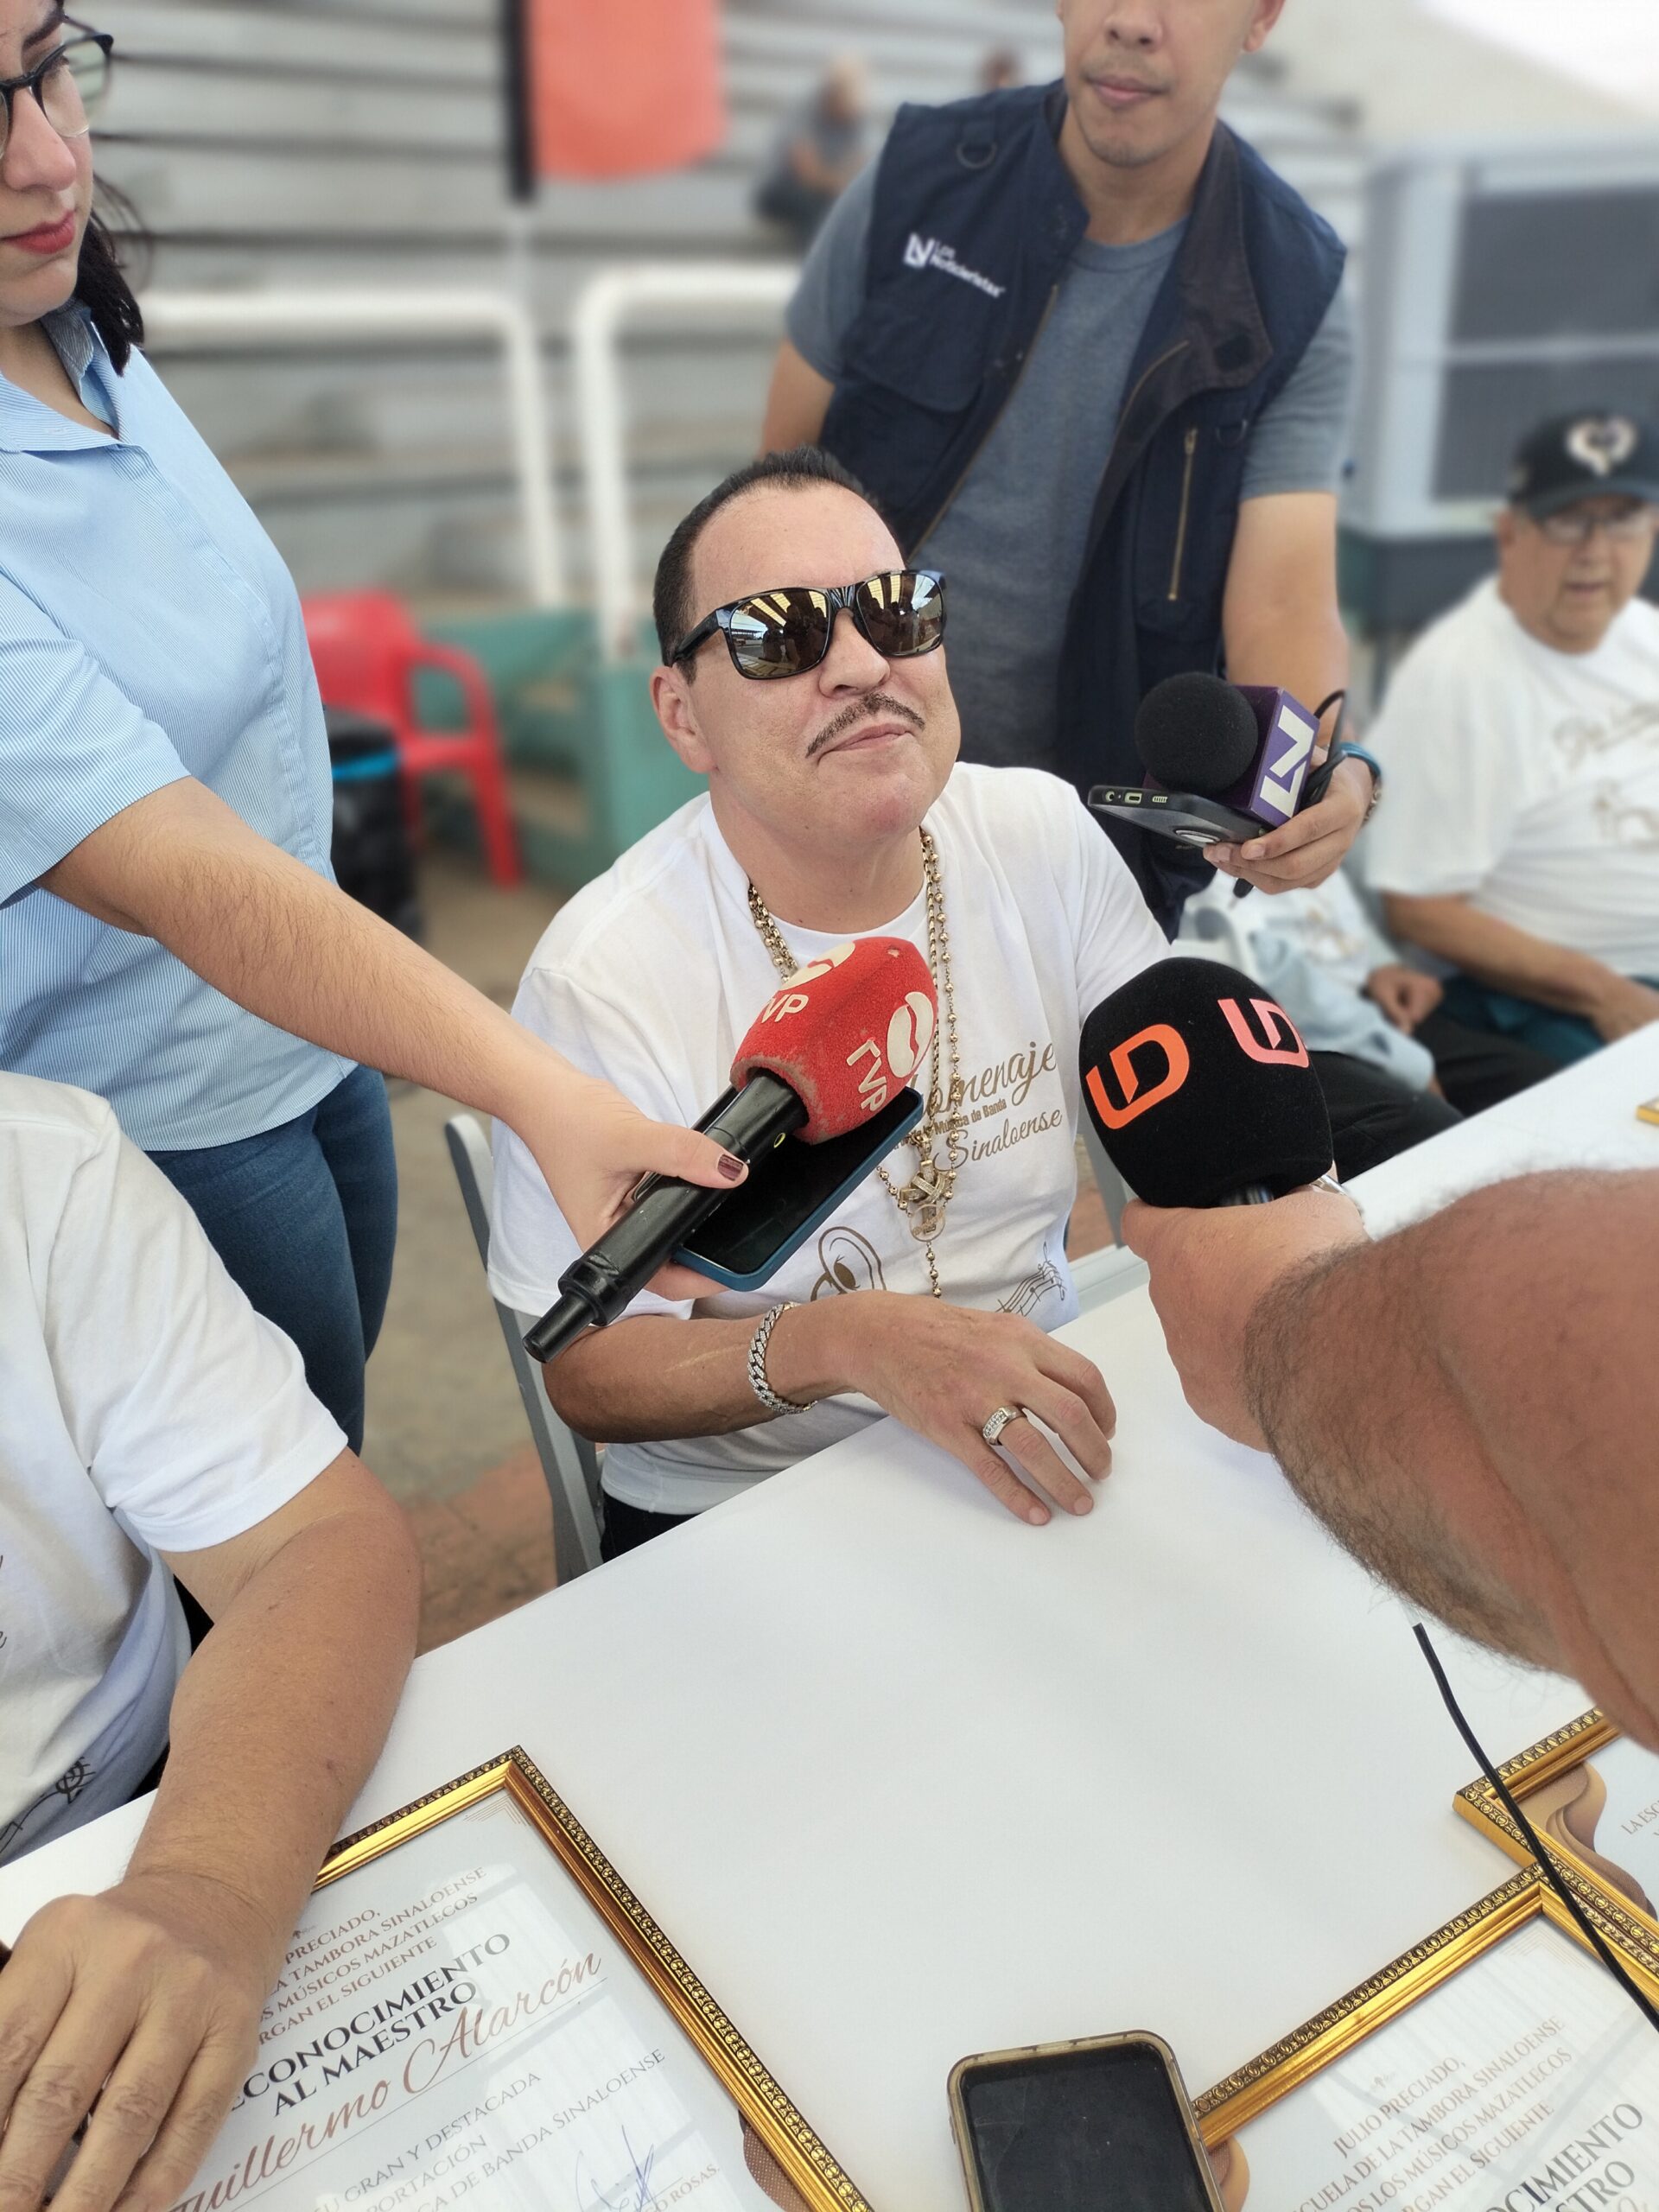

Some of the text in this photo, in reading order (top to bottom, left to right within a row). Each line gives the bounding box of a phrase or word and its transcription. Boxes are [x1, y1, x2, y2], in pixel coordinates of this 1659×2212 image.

[910, 1041, 1057, 1116] omenaje
[971, 1109, 982, 1123] de
[982, 1097, 1007, 1118] Banda
[932, 1109, 1063, 1173] Sinaloense
[1621, 1820, 1643, 1834] LA
[1637, 1800, 1659, 1823] ESC
[277, 1958, 361, 2012] MÚSICOS
[364, 1892, 478, 1964] MAZATLECOS
[285, 1909, 380, 1965] PRECIADO,
[289, 1929, 379, 1981] TAMBORA
[380, 1866, 486, 1932] SINALOENSE
[316, 1995, 340, 2012] EL
[340, 1936, 437, 1999] SIGUIENTE
[168, 1952, 601, 2212] uillermo Alarcón
[274, 1982, 476, 2117] AL MAESTRO
[344, 2157, 404, 2202] GRAN
[407, 2145, 420, 2160] Y
[425, 2073, 541, 2151] DESTACADA
[451, 2171, 482, 2198] DE
[481, 2126, 553, 2177] BANDA
[552, 2049, 665, 2130] SINALOENSE
[1294, 2016, 1565, 2212] CUELA DE LA TAMBORA SINALOENSE
[1332, 2056, 1466, 2158] JULIO PRECIADO,
[1370, 2046, 1573, 2207] LOS MÚSICOS MAZATLECOS
[1450, 2164, 1476, 2184] EL
[1470, 2100, 1554, 2169] SIGUIENTE
[1485, 2103, 1643, 2212] CIMIENTO
[670, 2164, 720, 2202] ROSAS.
